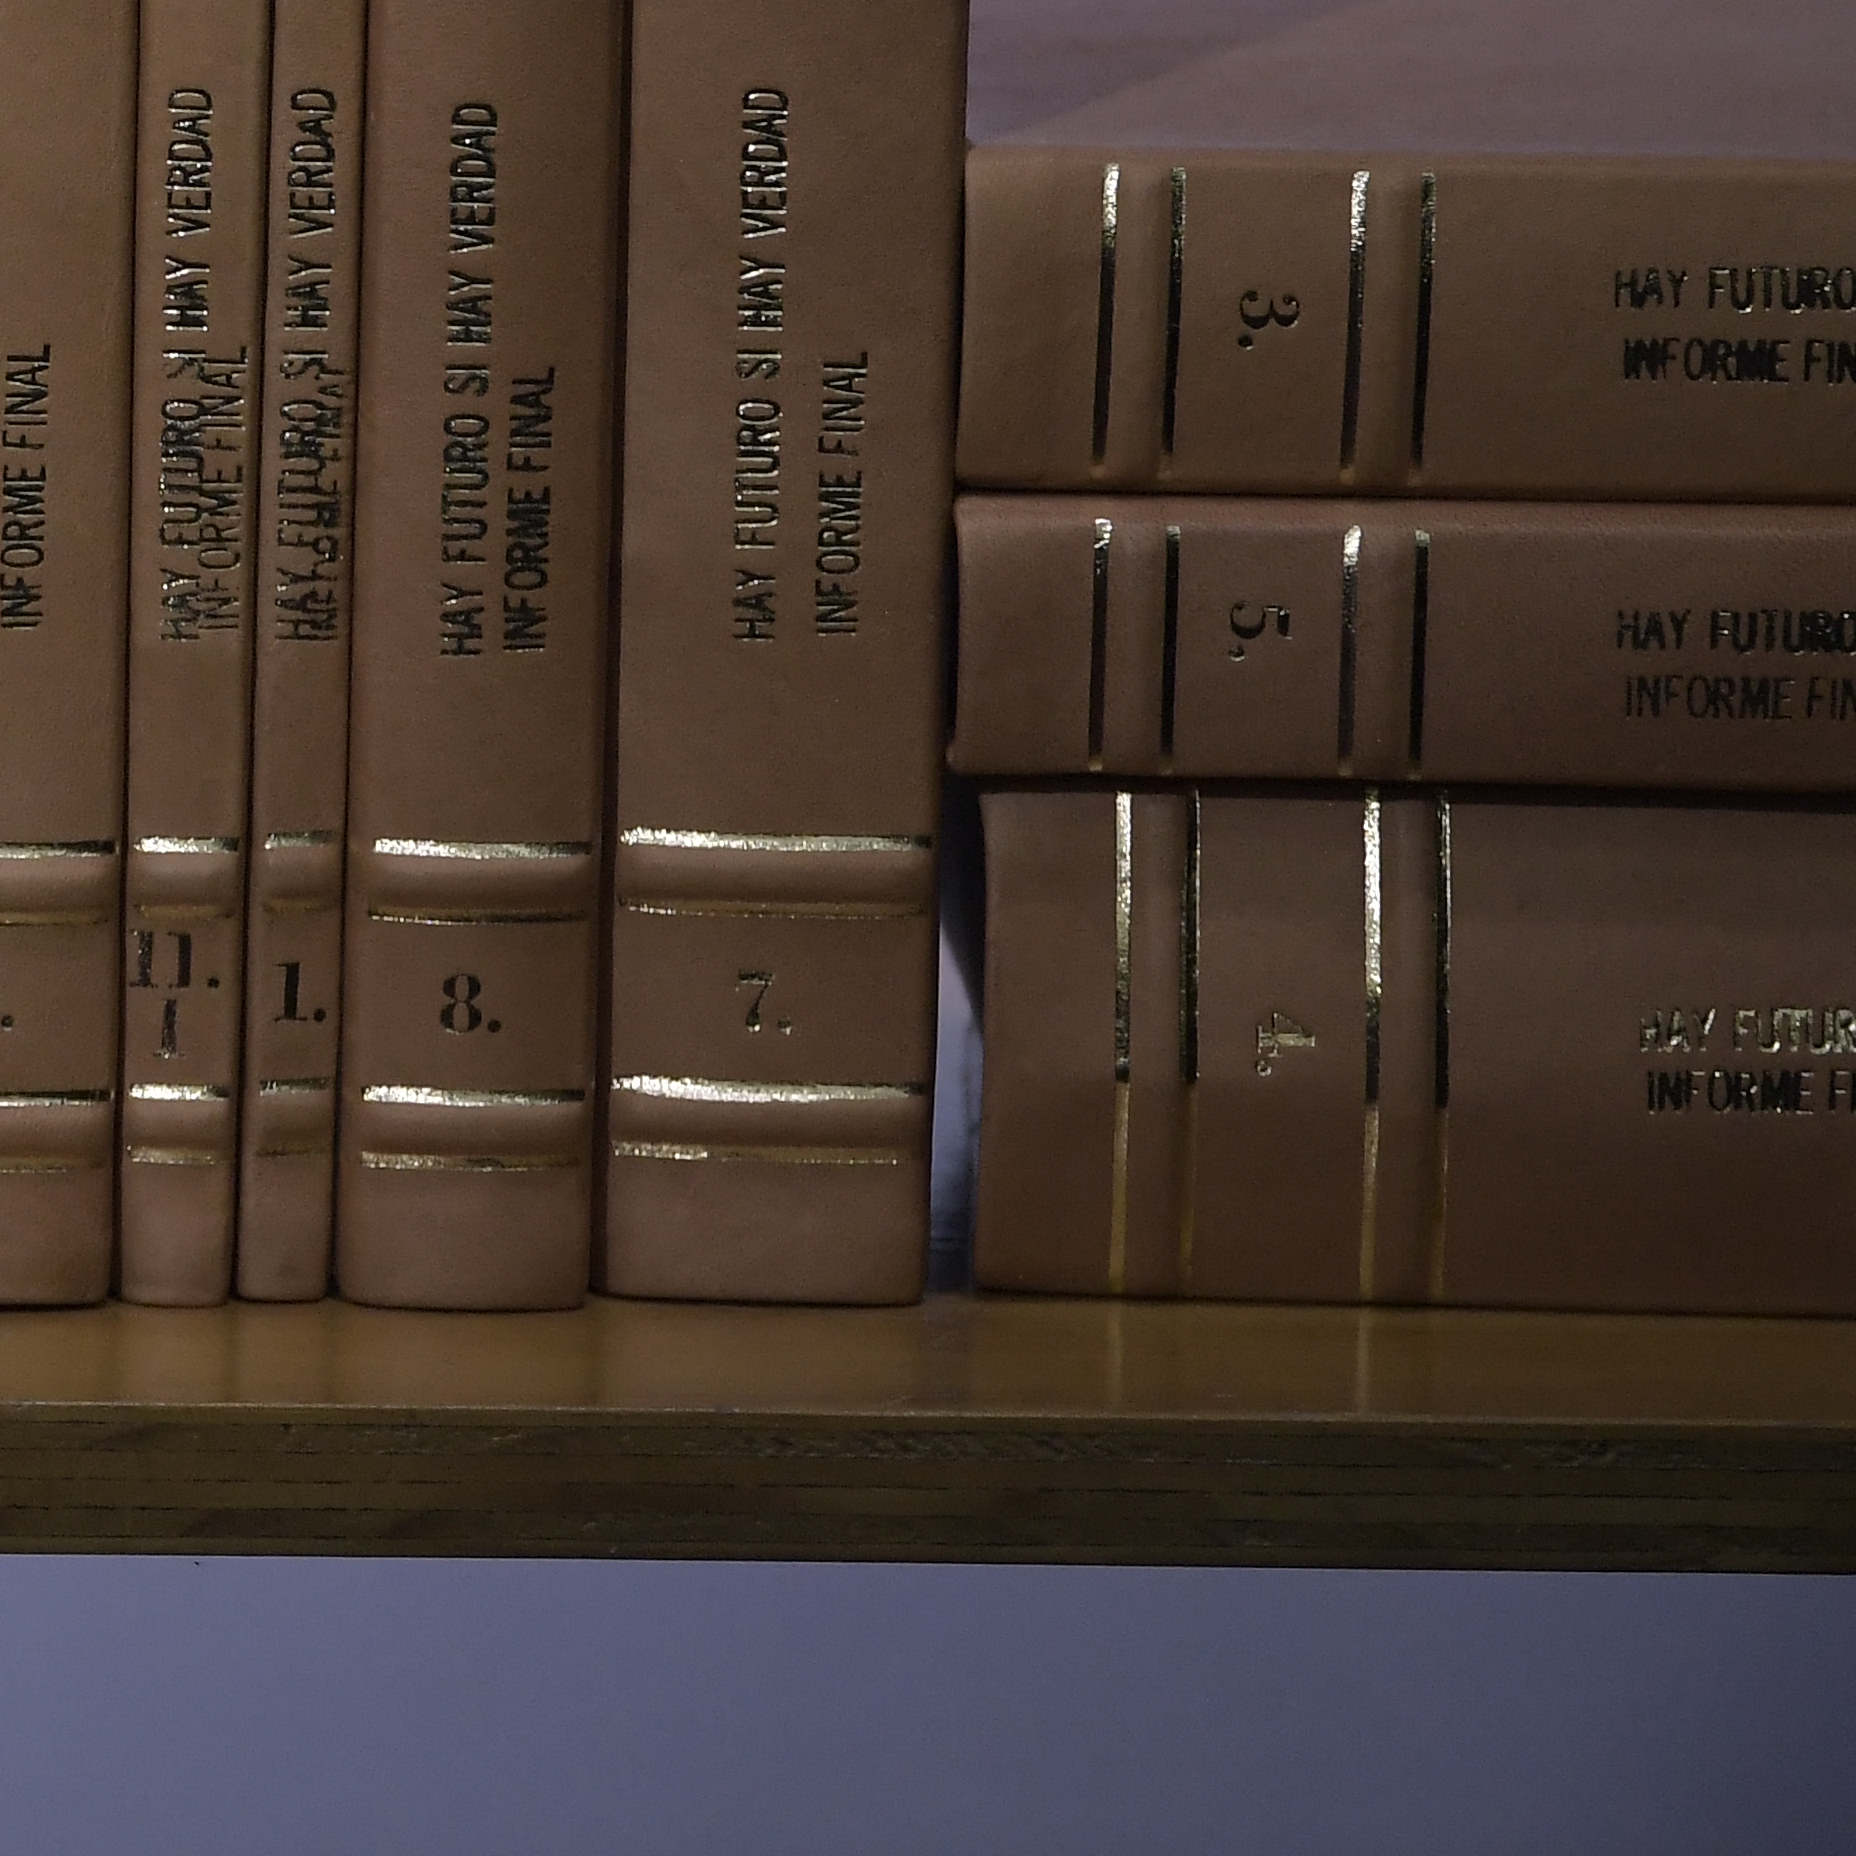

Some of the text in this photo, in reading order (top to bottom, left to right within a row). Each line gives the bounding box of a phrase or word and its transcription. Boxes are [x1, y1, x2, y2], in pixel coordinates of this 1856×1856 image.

[1237, 289, 1301, 352] 3.
[1614, 267, 1690, 313] HAY
[733, 87, 788, 642] HAY FUTURO SI HAY VERDAD
[1621, 338, 1790, 385] INFORME
[0, 344, 50, 630] INFORME FINAL
[815, 351, 868, 637] INFORME FINAL
[1228, 599, 1294, 664] 5.
[1616, 609, 1692, 653] HAY
[1625, 675, 1794, 721] INFORME
[128, 928, 221, 990] 11.
[273, 960, 327, 1023] 1.
[439, 971, 503, 1036] 8.
[735, 969, 794, 1036] 7.
[1639, 1007, 1716, 1056] HAY
[1646, 1069, 1815, 1118] INFORME
